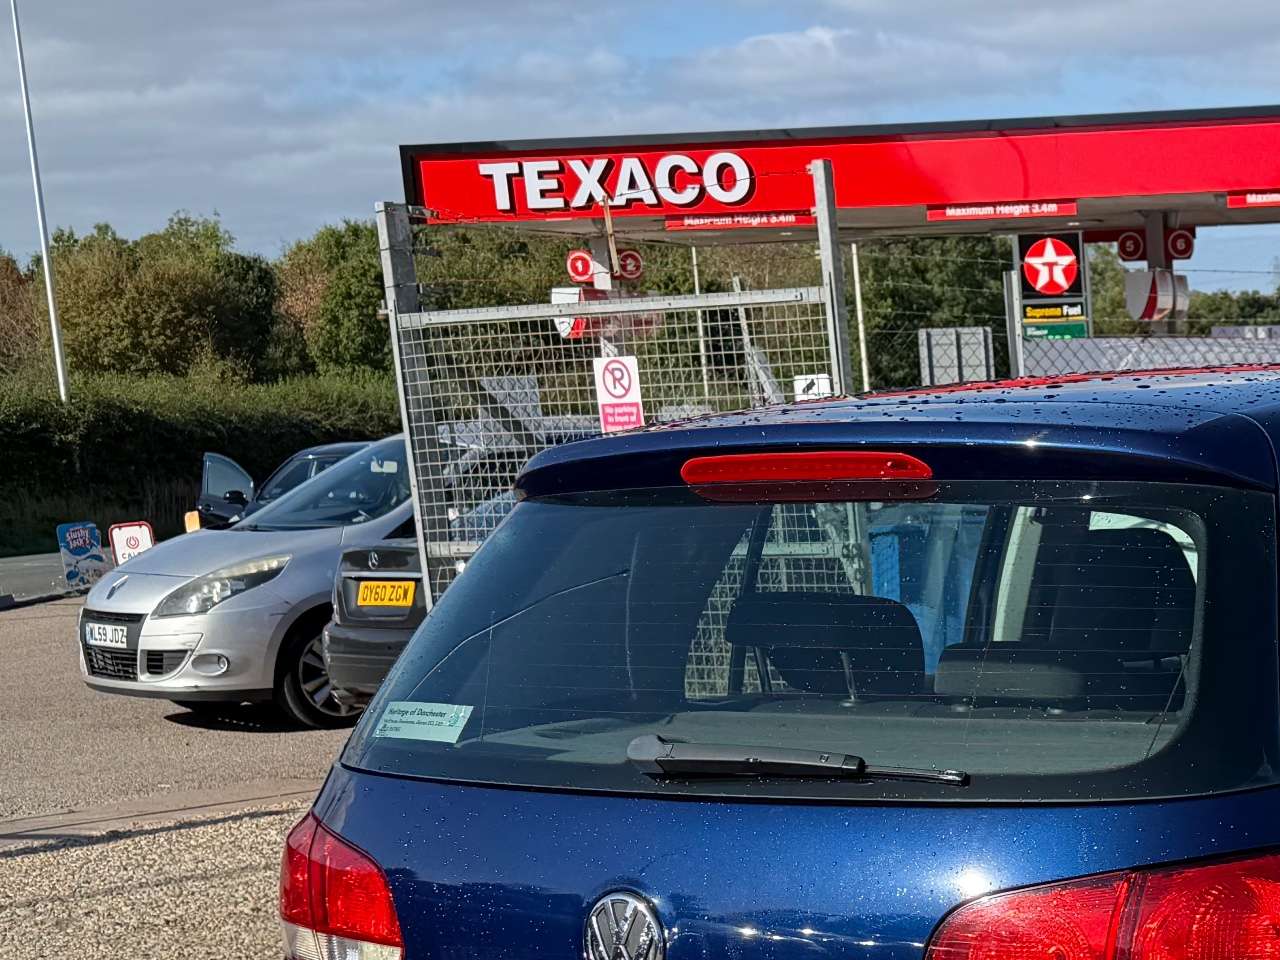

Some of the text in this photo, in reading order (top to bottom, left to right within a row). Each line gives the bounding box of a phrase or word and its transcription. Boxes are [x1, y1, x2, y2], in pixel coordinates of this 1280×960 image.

[479, 152, 751, 210] TEXACO
[945, 203, 1058, 216] Maximum Height 3.4m
[684, 214, 796, 226] Maximum Height 3.4m
[1125, 240, 1135, 252] 5
[1176, 239, 1186, 250] 6
[575, 259, 583, 272] 1
[626, 258, 636, 271] 2
